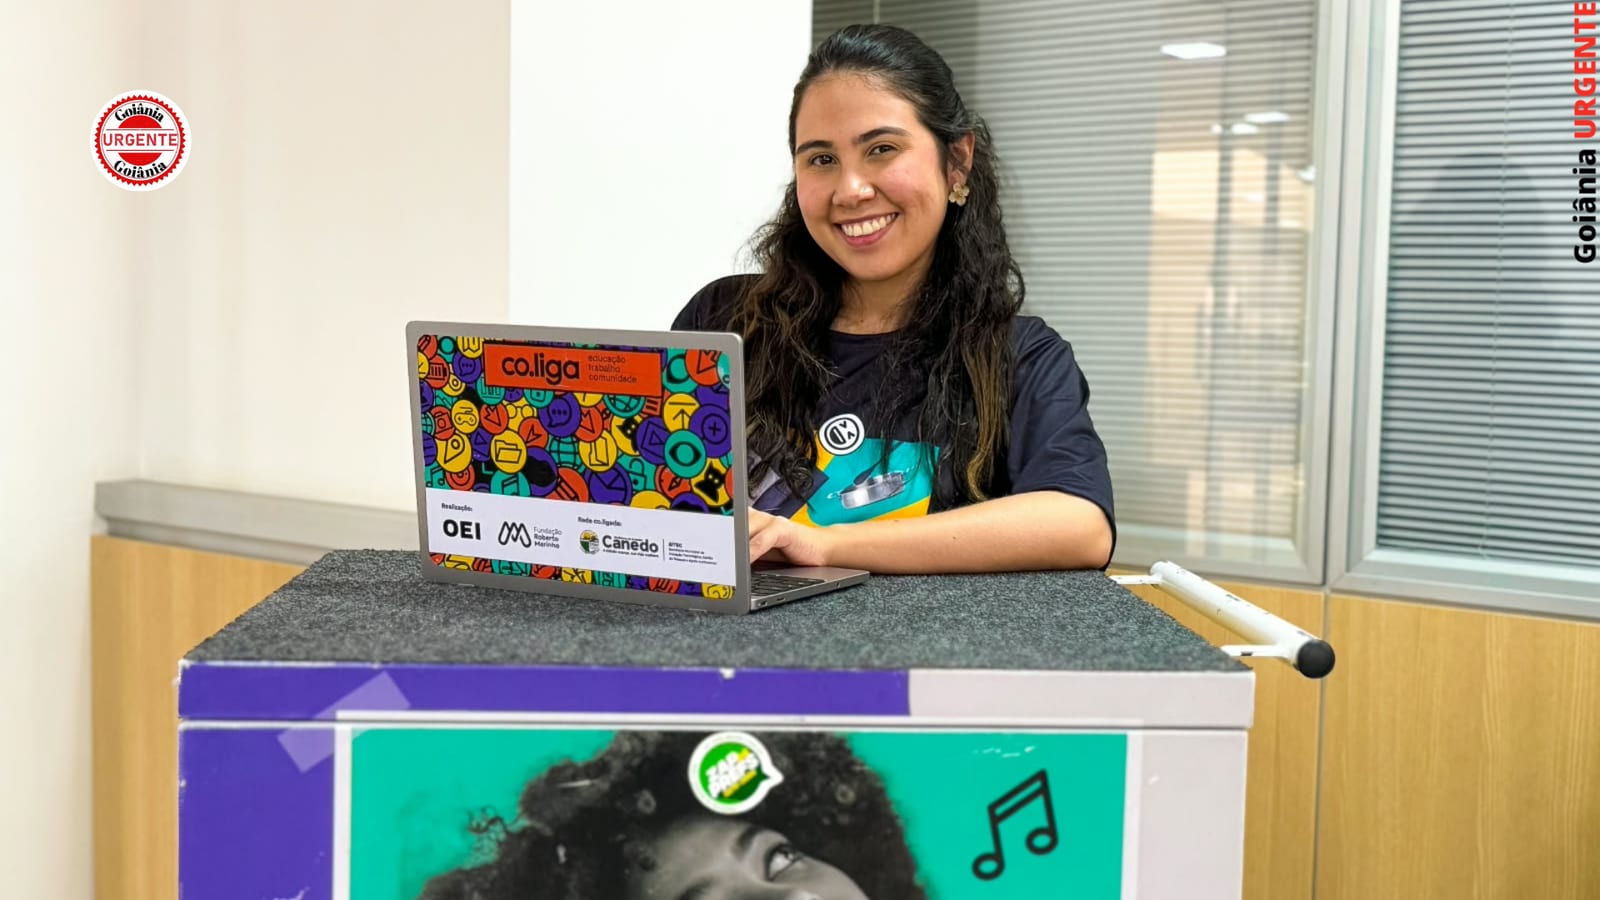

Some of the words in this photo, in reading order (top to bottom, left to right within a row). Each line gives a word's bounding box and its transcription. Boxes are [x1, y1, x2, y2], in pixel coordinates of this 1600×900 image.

[588, 355, 626, 364] educação
[502, 353, 580, 385] co.liga
[588, 364, 621, 373] trabalho
[589, 374, 637, 383] comunidade
[443, 519, 481, 540] OEI
[534, 527, 562, 536] Fundação
[534, 533, 559, 542] Roberto
[534, 541, 560, 549] Marinho
[602, 535, 659, 553] Canedo
